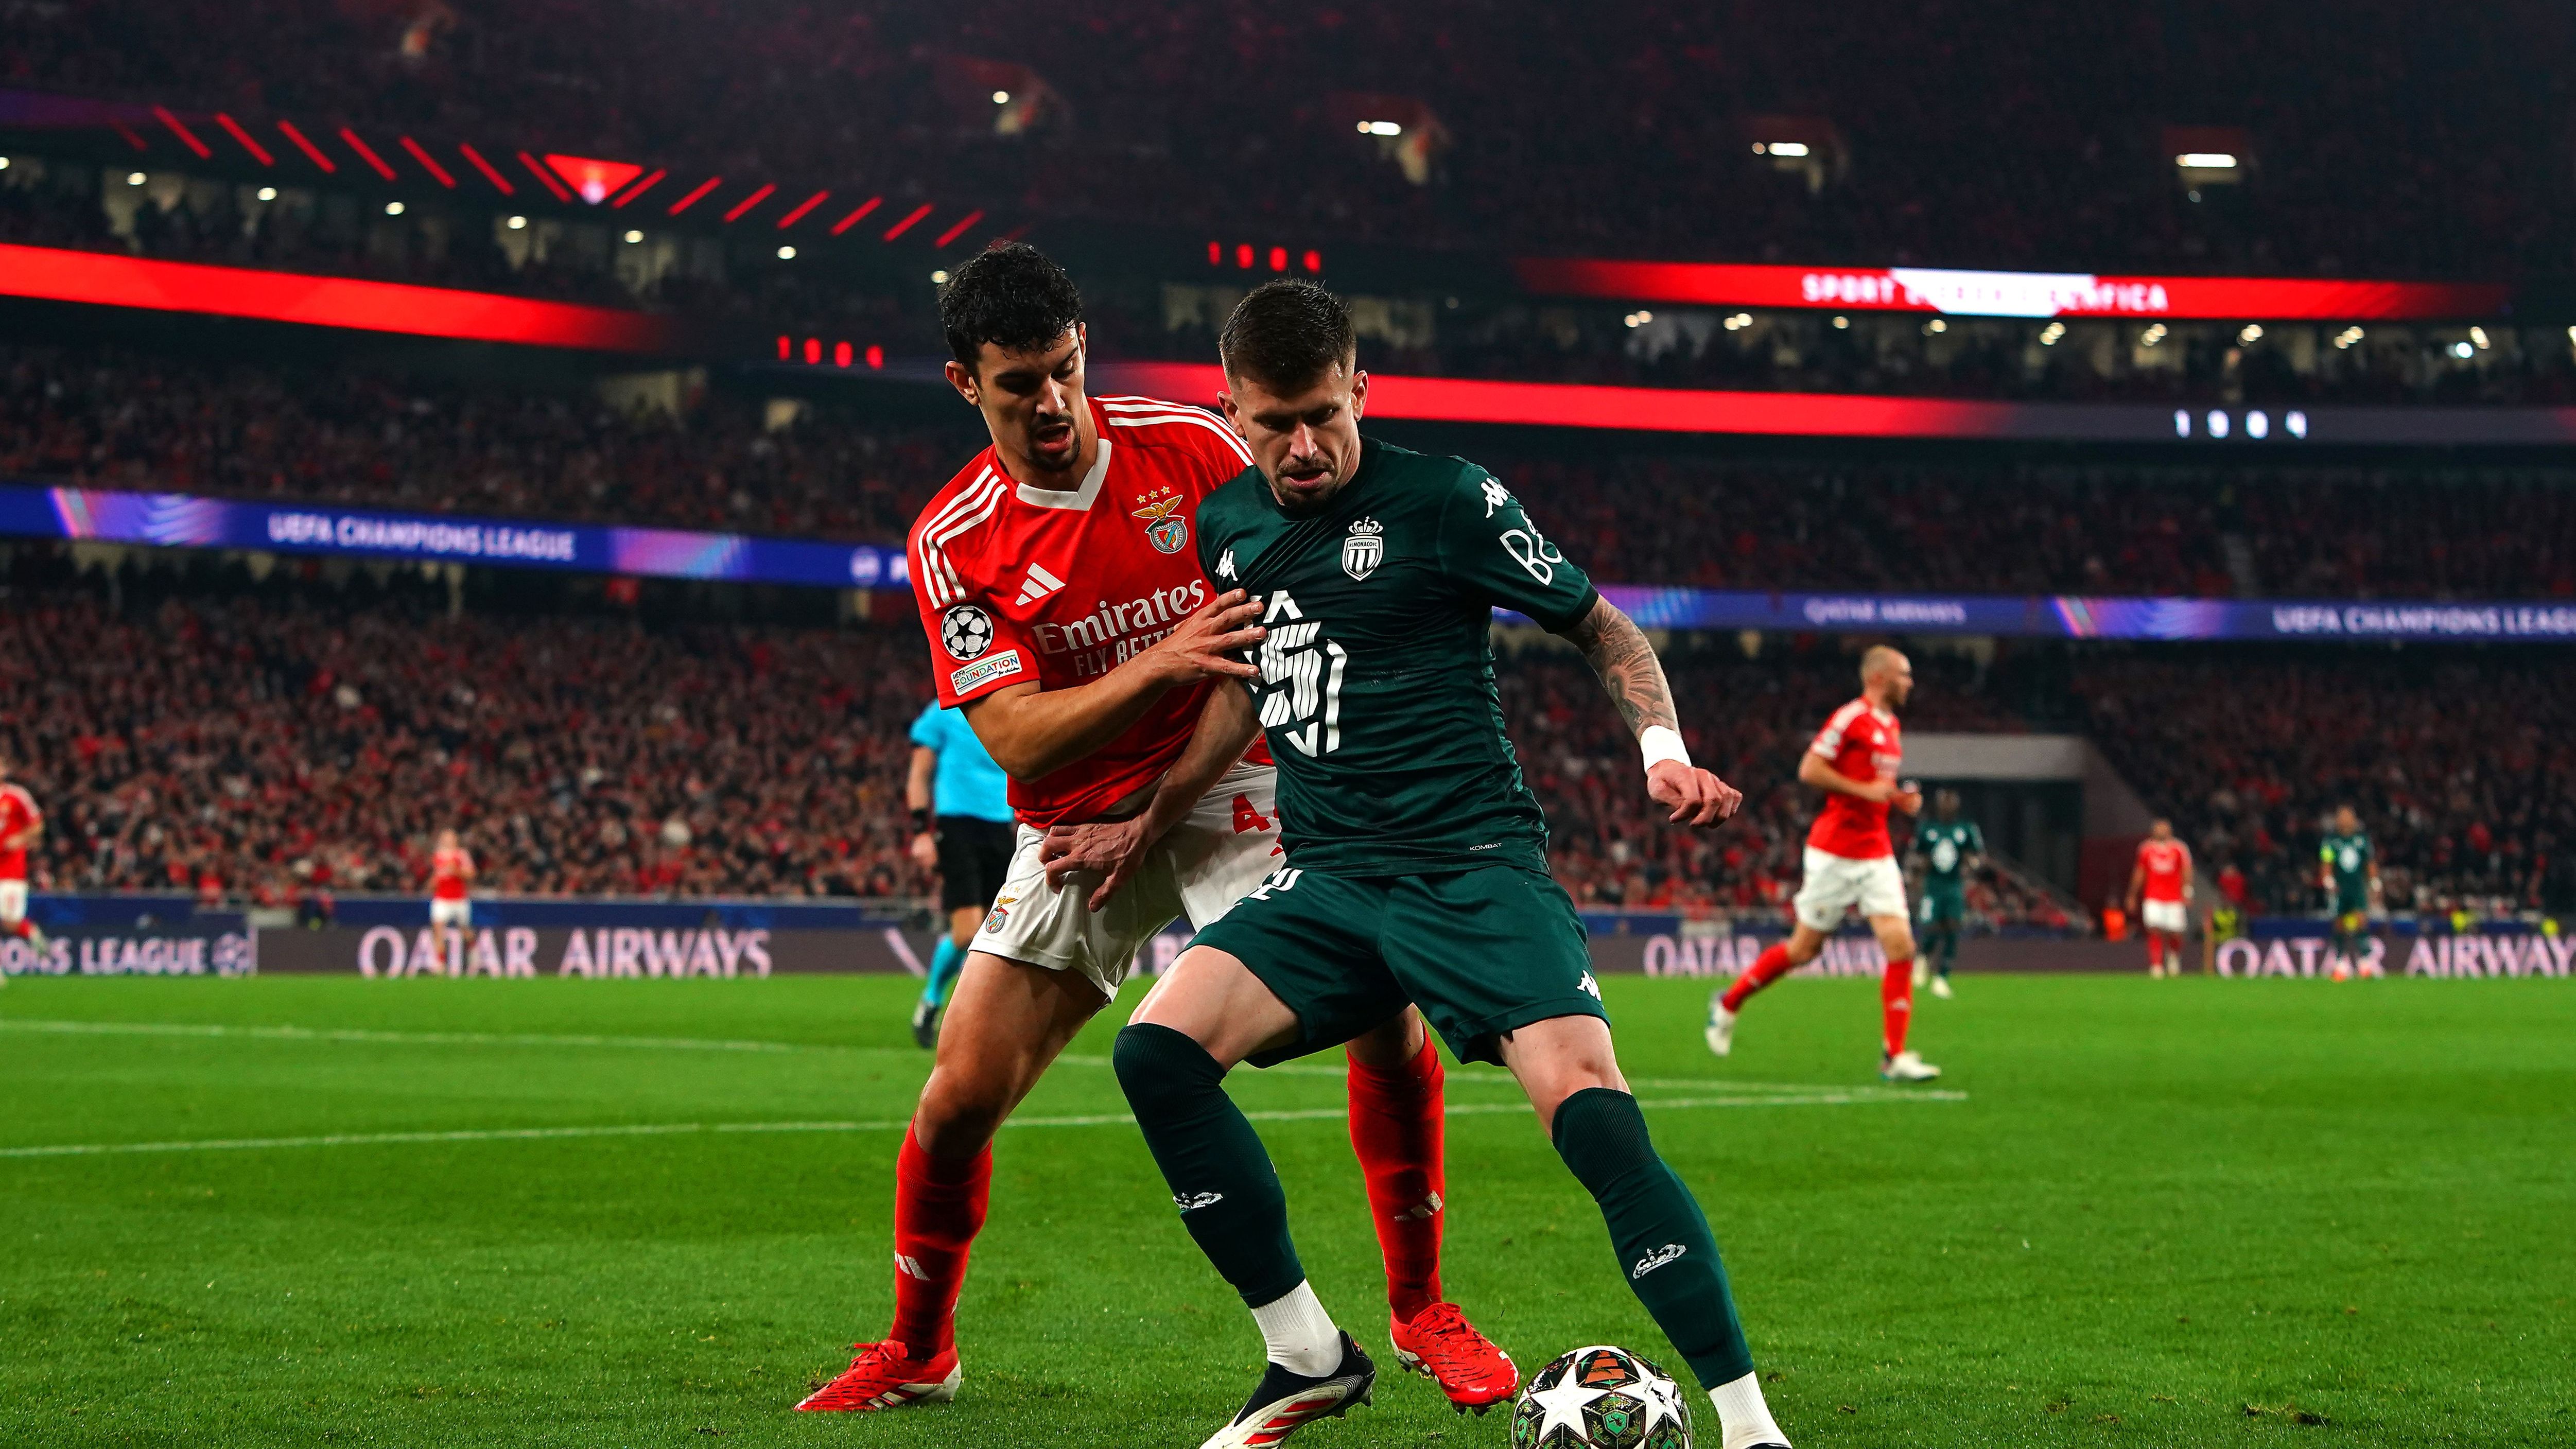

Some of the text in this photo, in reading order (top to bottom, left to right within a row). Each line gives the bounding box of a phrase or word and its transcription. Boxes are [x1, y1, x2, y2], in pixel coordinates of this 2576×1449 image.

[1803, 274, 1894, 305] SPORT
[268, 513, 575, 560] UEFA CHAMPIONS LEAGUE
[1032, 580, 1204, 654] Emirates
[2273, 606, 2341, 634] UEFA
[2343, 606, 2500, 634] CHAMPIONS
[953, 670, 965, 679] UEFA
[1074, 648, 1107, 676] FLY
[1470, 843, 1502, 851] KOMBAT
[80, 937, 207, 974] LEAGUE
[358, 926, 771, 979] QATAR AIRWAYS
[1643, 934, 1761, 978] QATAR
[2216, 937, 2386, 979] QATAR
